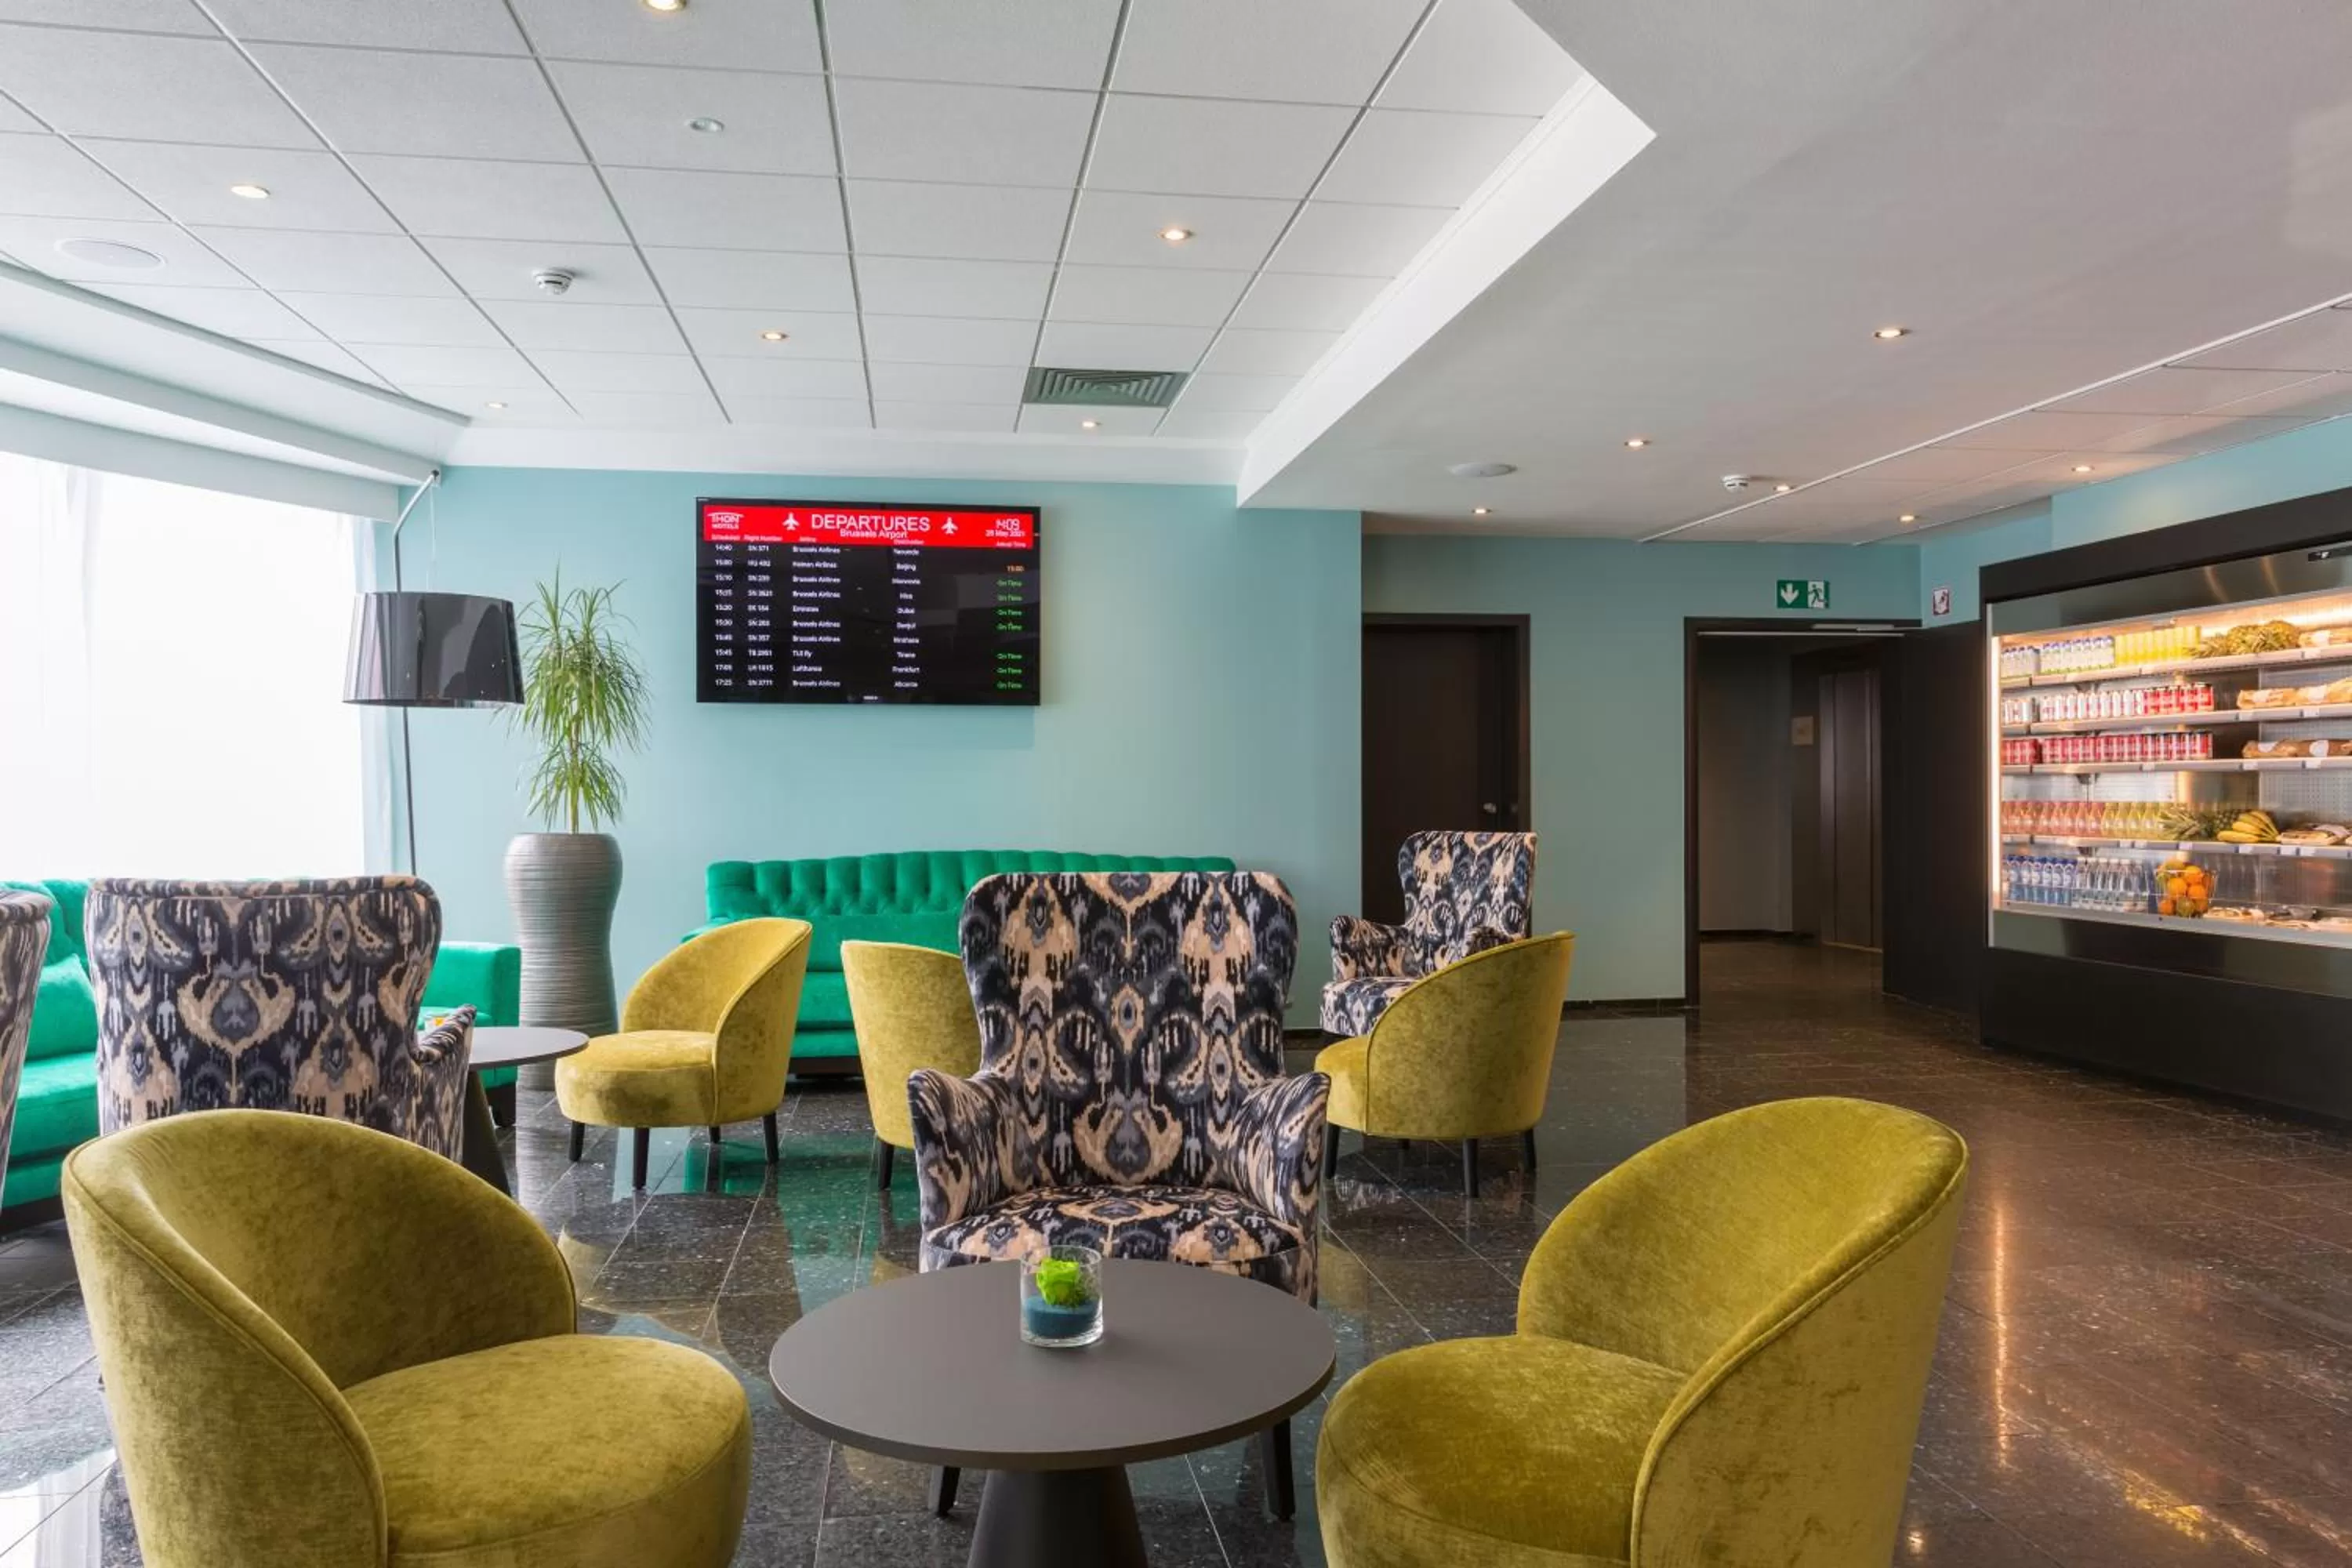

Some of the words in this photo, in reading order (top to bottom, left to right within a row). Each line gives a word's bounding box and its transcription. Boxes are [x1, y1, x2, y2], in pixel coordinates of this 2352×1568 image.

[811, 514, 931, 531] DEPARTURES
[840, 528, 877, 537] Brussels
[879, 530, 907, 539] Airport
